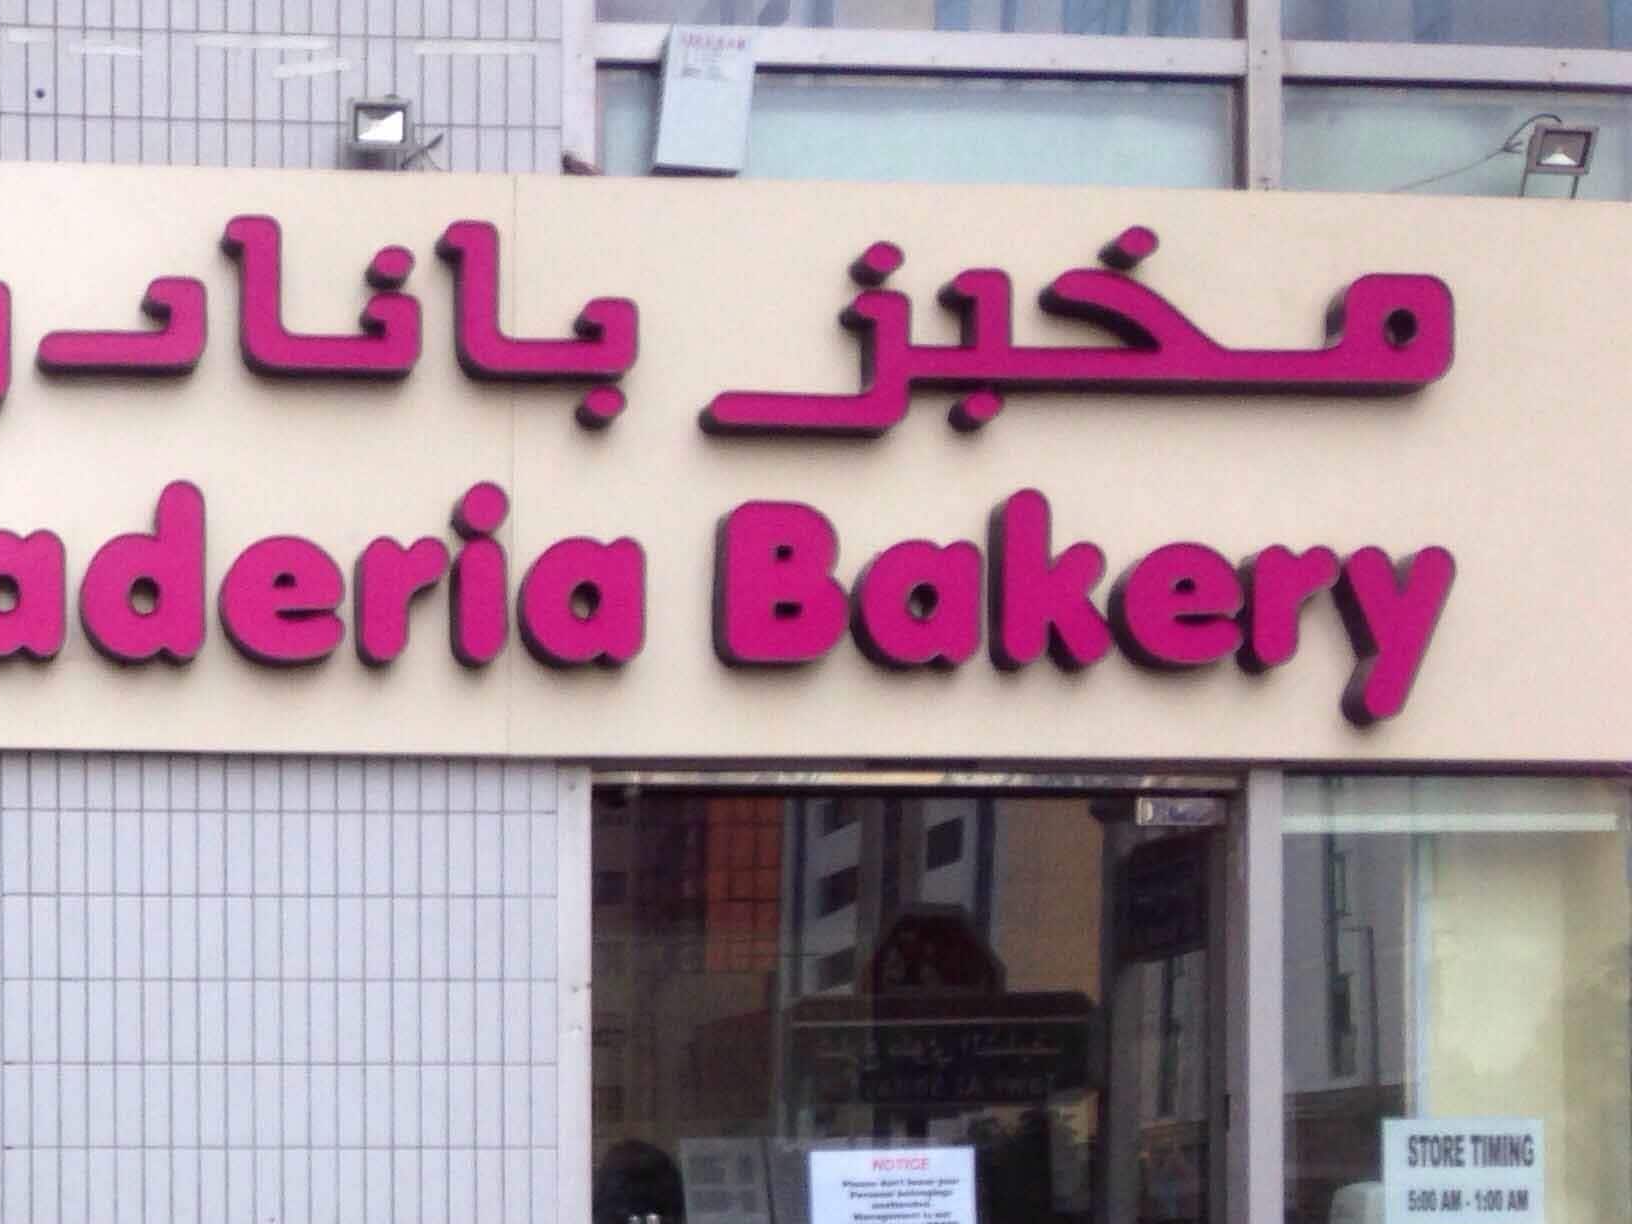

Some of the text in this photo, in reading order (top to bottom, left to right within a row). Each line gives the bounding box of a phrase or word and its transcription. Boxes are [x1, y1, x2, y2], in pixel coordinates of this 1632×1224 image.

[698, 225, 1455, 450] مخبز
[712, 488, 1456, 735] Bakery
[872, 1157, 929, 1171] NOTICE
[1407, 1133, 1535, 1168] STORE TIMING
[1407, 1189, 1437, 1212] 5:00
[1441, 1189, 1462, 1212] AM
[1474, 1189, 1504, 1212] 1:00
[1507, 1189, 1529, 1212] AM
